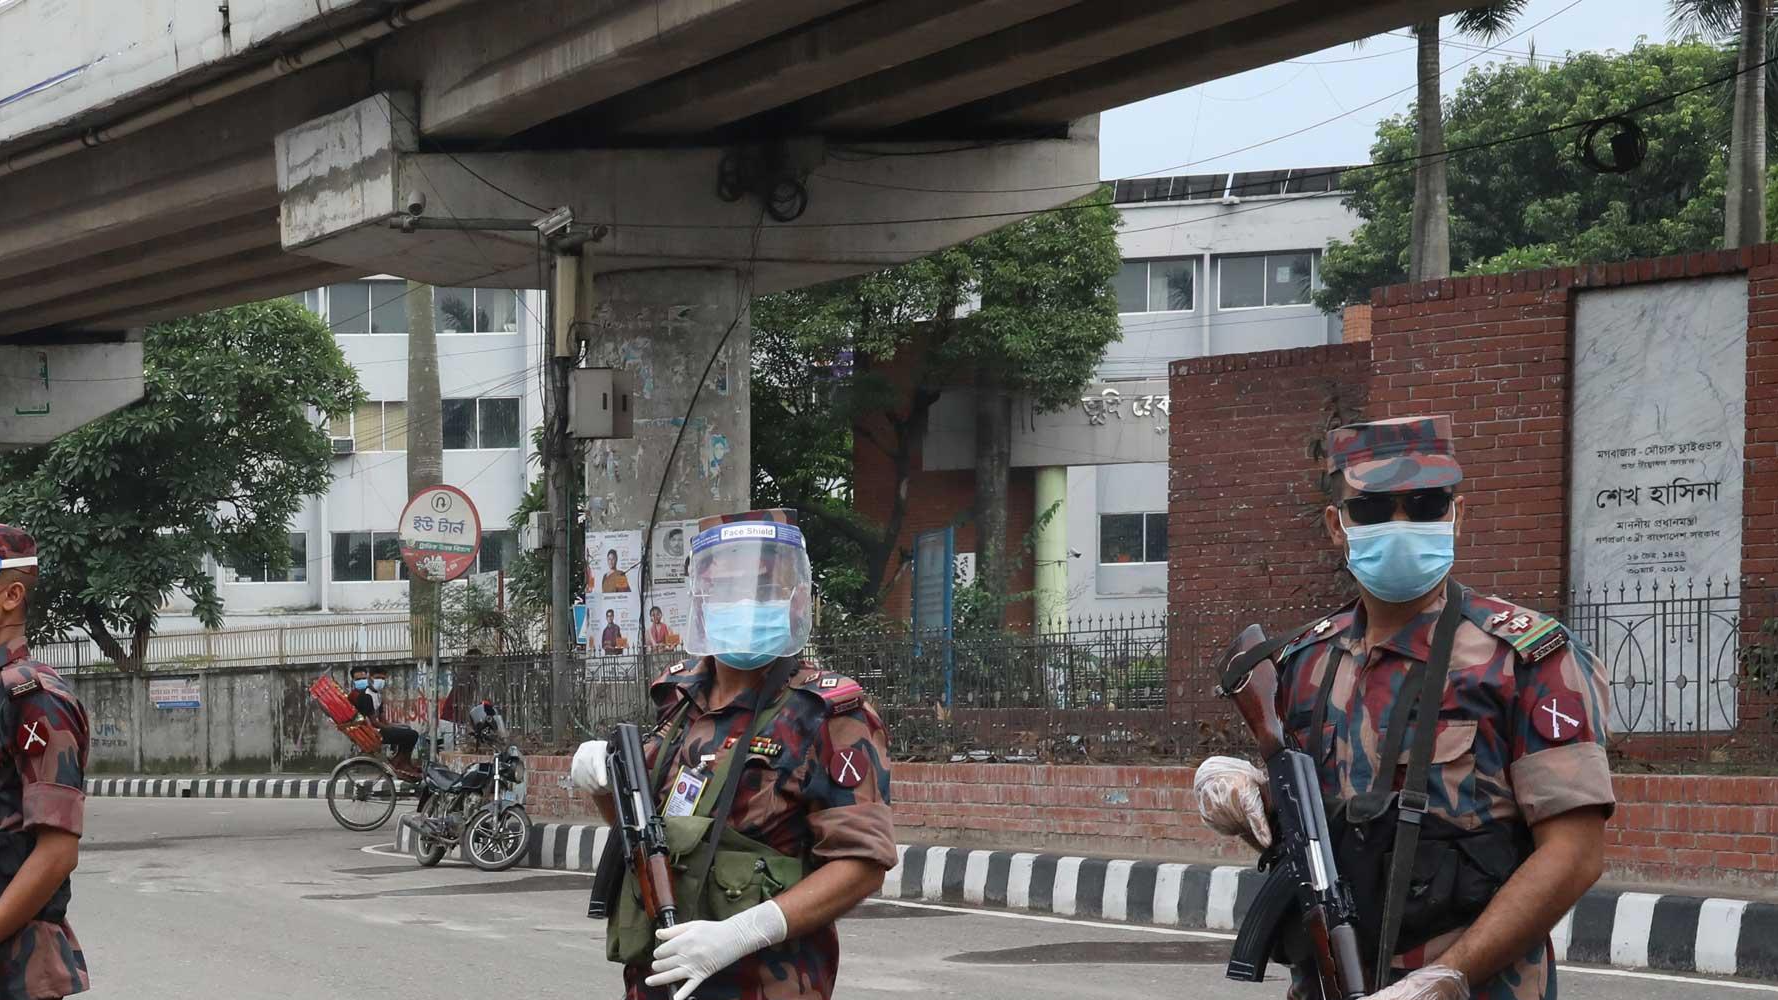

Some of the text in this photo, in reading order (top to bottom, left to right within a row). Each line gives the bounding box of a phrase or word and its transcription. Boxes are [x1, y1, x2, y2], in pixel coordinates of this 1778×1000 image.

[1596, 446, 1637, 459] মগবাজার
[1645, 444, 1675, 456] মৌচাক
[1678, 440, 1722, 455] ফ্লাইওভার
[1596, 477, 1722, 509] শেখ হাসিনা
[413, 516, 465, 534] ইউ টার্ন
[1616, 514, 1698, 530] মাননীয় প্রধানমন্ত্রী
[747, 527, 773, 536] Shield
[1646, 532, 1687, 542] বাংলাদেশ
[1690, 529, 1721, 539] সরকার
